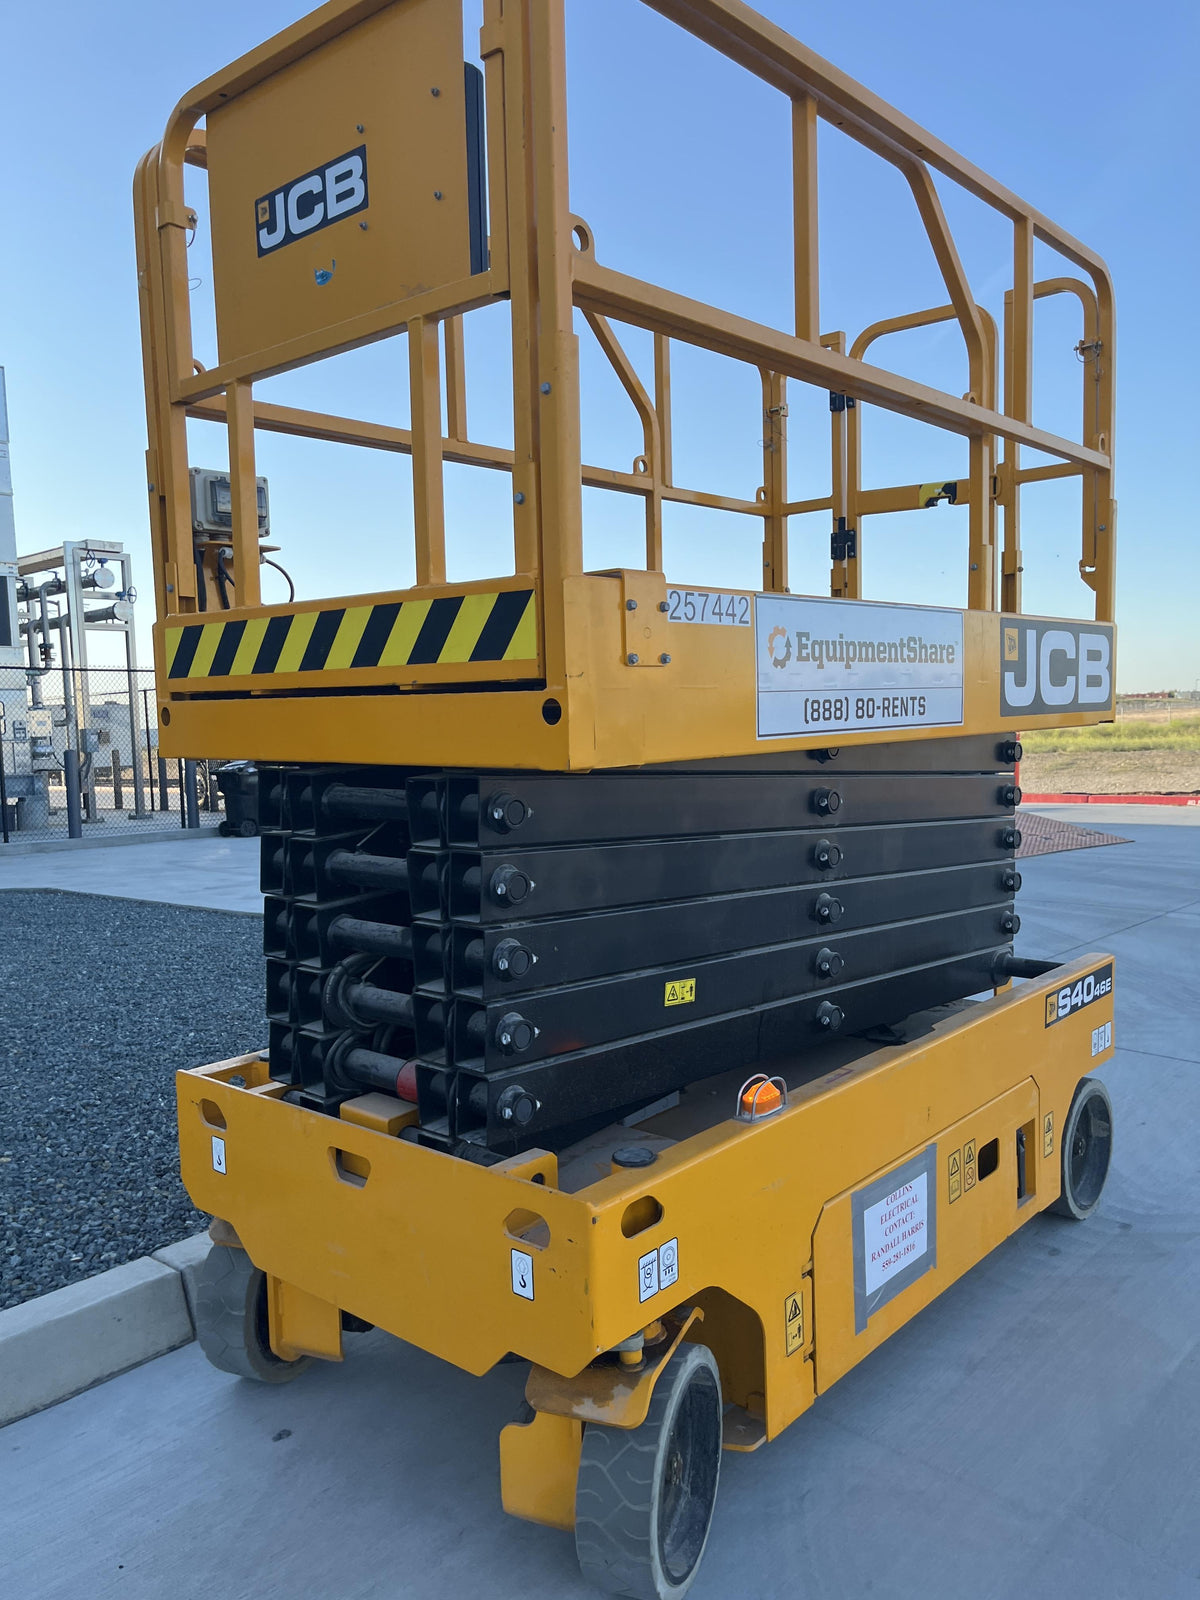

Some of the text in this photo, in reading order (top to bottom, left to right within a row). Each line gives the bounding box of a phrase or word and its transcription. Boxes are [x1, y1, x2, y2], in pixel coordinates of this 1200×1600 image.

[259, 155, 365, 249] JCB
[669, 590, 749, 624] 257442
[795, 631, 955, 669] EquipmentShare
[1004, 629, 1110, 707] JCB
[804, 696, 926, 724] (888) 80-RENTS
[880, 1194, 919, 1225] ELECTRICAL
[886, 1183, 913, 1206] COLLINS
[871, 1219, 925, 1262] RANDALL HARRIS
